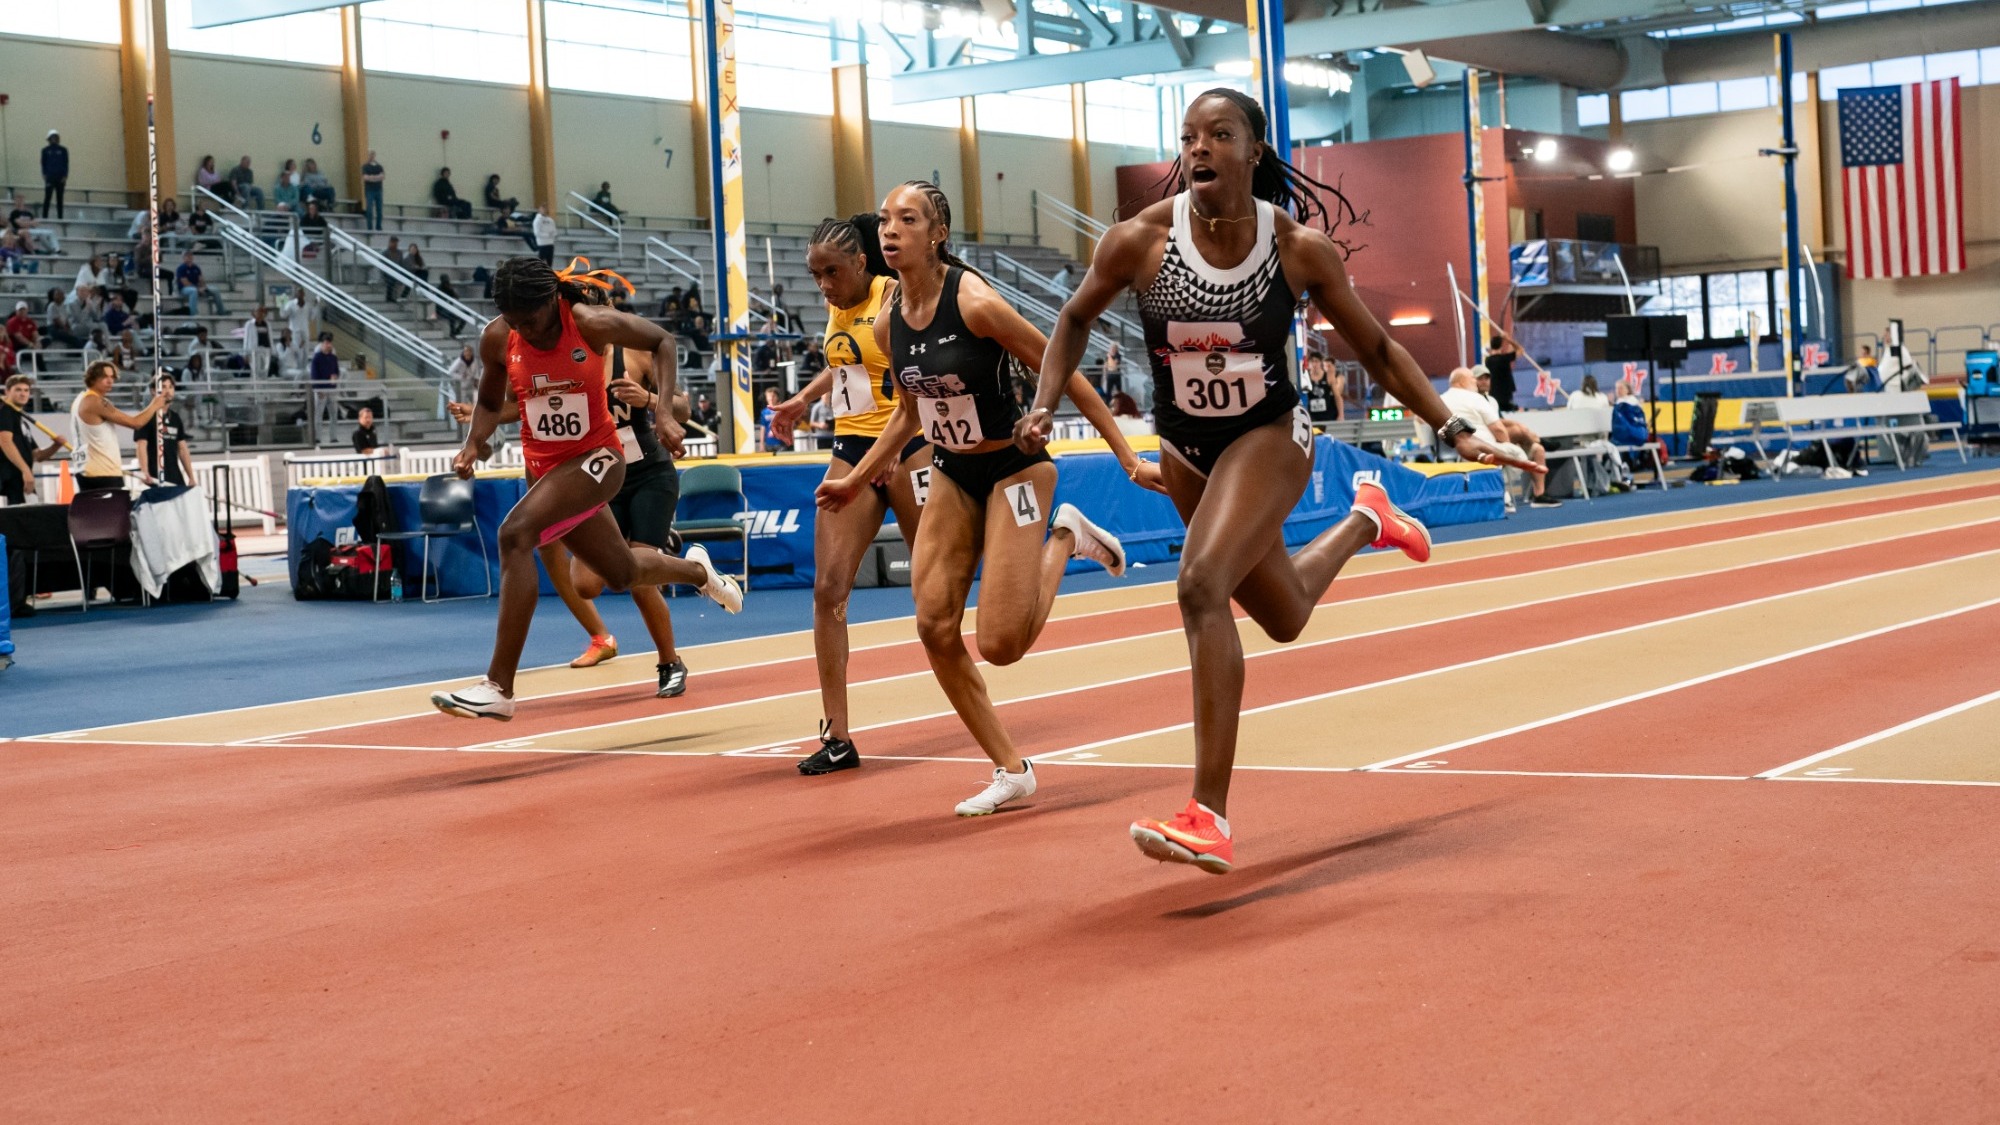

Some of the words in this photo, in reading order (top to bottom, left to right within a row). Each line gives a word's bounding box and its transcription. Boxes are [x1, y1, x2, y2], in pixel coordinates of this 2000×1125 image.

[311, 122, 322, 145] 6
[664, 149, 673, 169] 7
[932, 169, 940, 187] 8
[938, 334, 957, 345] SLC
[841, 386, 851, 411] 1
[1186, 377, 1248, 410] 301
[537, 412, 582, 436] 486
[931, 419, 977, 445] 412
[588, 455, 614, 476] 6
[916, 469, 930, 503] 5
[1017, 485, 1035, 521] 4
[731, 508, 800, 534] GILL
[1403, 760, 1449, 769] 3
[1803, 767, 1855, 776] 2
